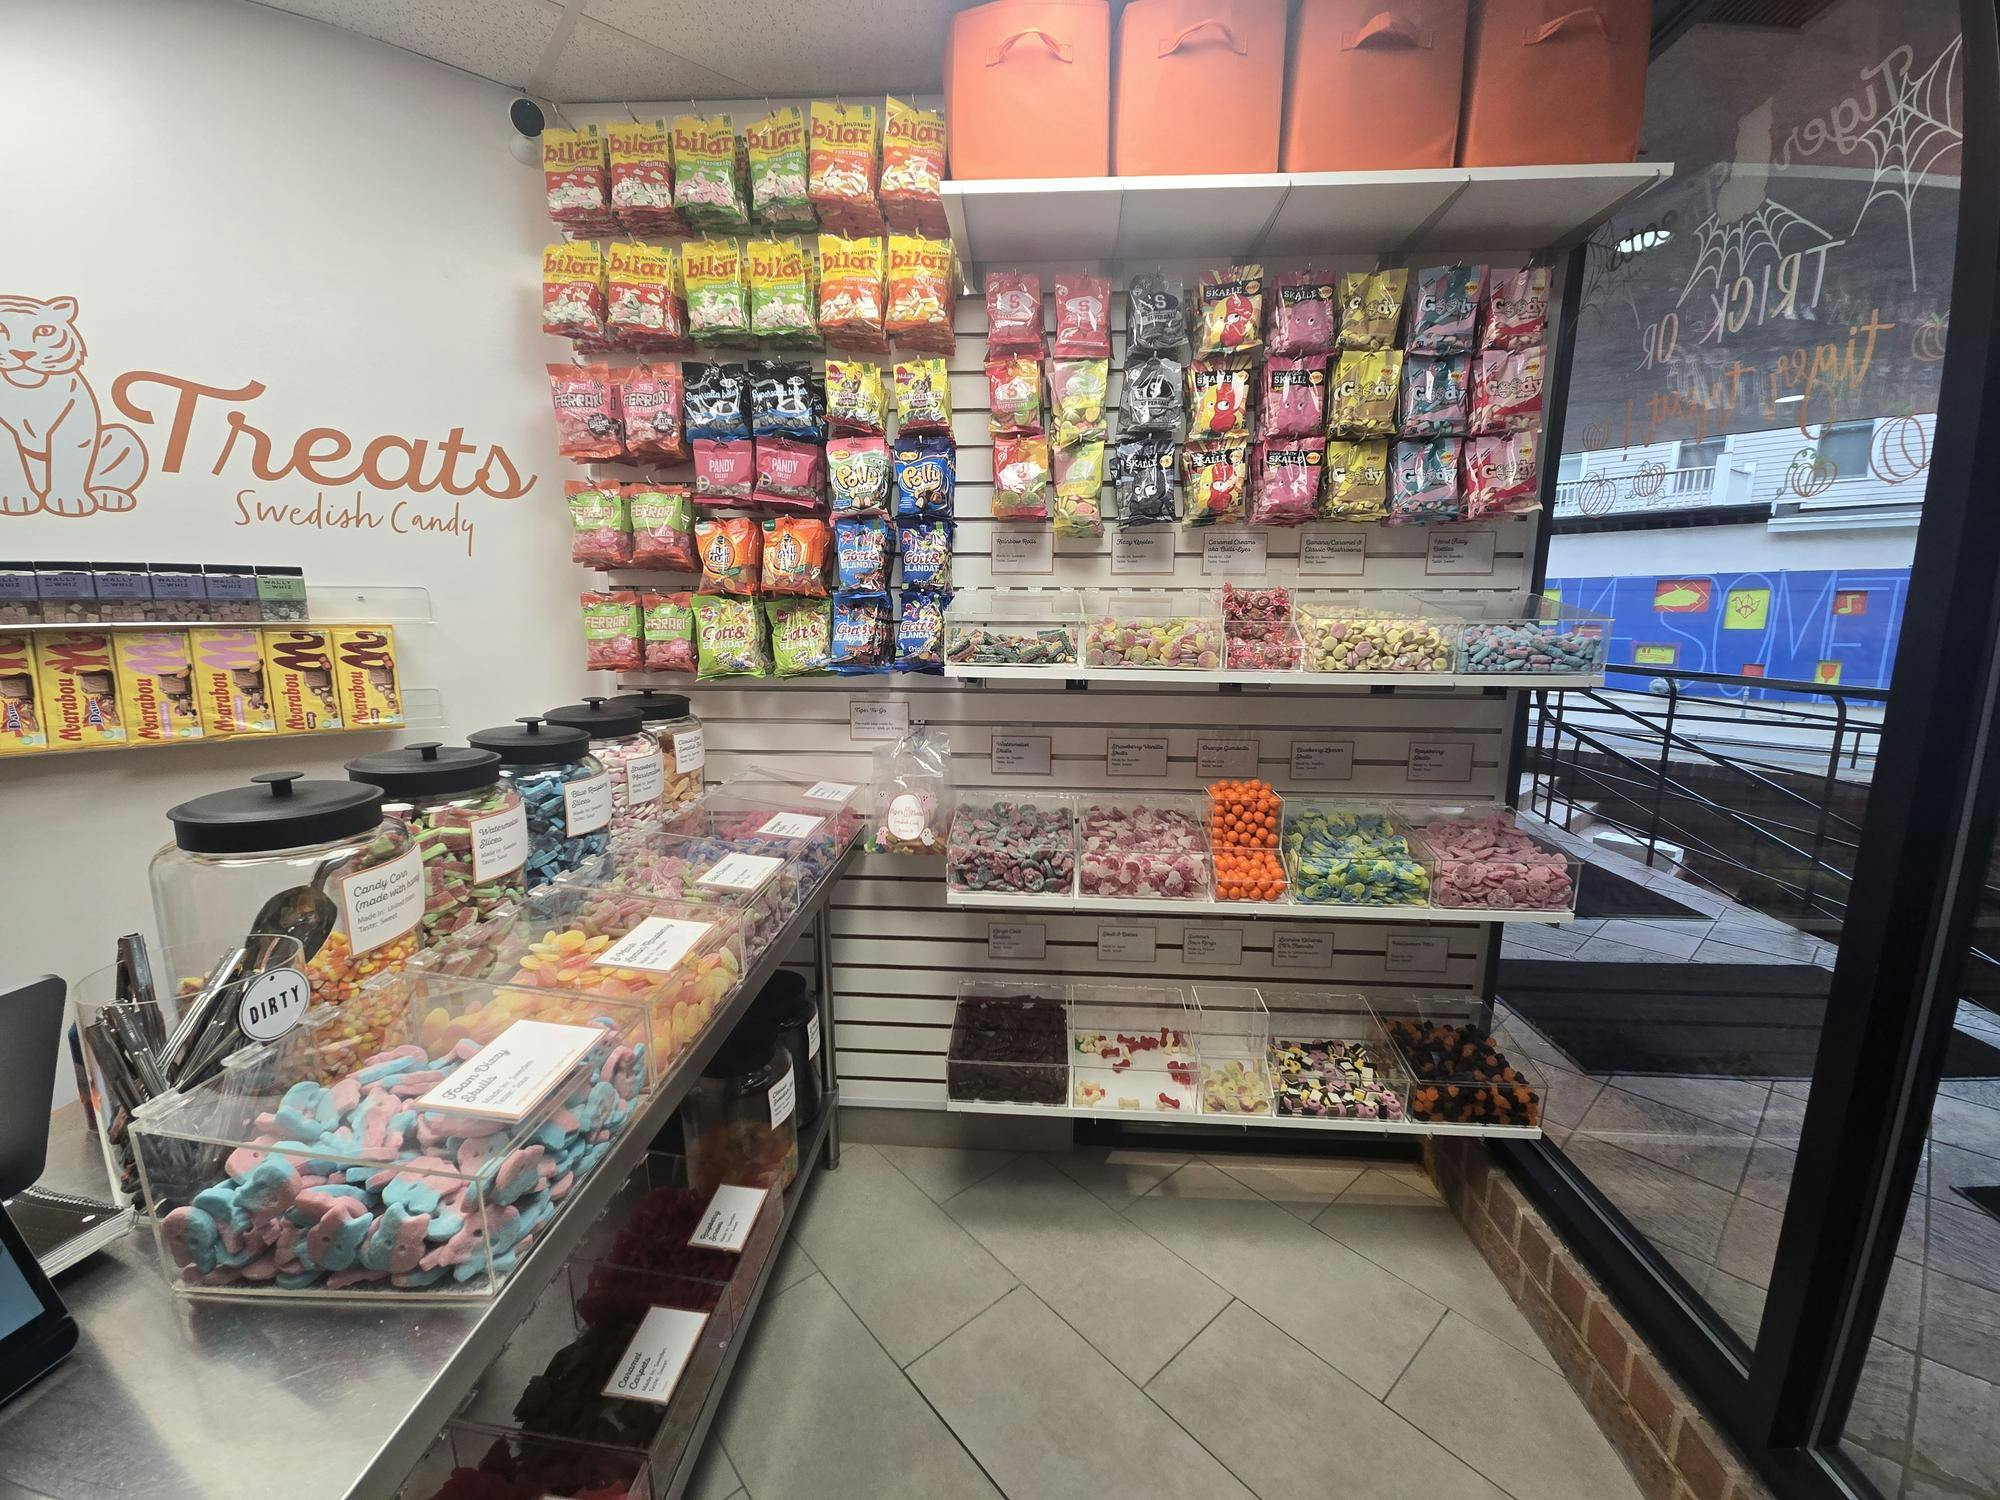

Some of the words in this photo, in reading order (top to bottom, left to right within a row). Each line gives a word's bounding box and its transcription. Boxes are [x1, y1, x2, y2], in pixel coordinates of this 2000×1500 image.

[746, 129, 803, 150] bilar
[811, 117, 871, 145] bilar
[886, 113, 943, 144] bilar
[610, 134, 665, 155] bilar
[674, 129, 732, 154] bilar
[545, 143, 601, 164] bilar
[544, 253, 599, 274] bilar
[610, 252, 668, 277] bilar
[687, 255, 738, 278] bilar
[822, 251, 877, 271] bilar
[892, 249, 950, 271] bilar
[1206, 284, 1243, 299] SKALLE
[1284, 288, 1318, 300] SKALLE
[1422, 296, 1478, 319] Goody
[623, 392, 670, 408] FERRARI
[1340, 381, 1397, 402] Goody
[1486, 377, 1545, 403] Goody
[111, 371, 537, 499] Treats
[709, 458, 736, 474] PANDY
[772, 457, 799, 475] PANDY
[1126, 457, 1159, 469] SKALLE
[1269, 454, 1303, 464] SKALLE
[1483, 458, 1537, 482] Goody
[837, 462, 878, 491] Polly
[902, 463, 942, 491] Polly
[1332, 467, 1385, 486] Goody
[1402, 465, 1458, 486] Goody
[235, 490, 384, 527] Swedish
[391, 501, 475, 557] Candy
[904, 564, 939, 573] BLANDAT
[584, 615, 630, 630] FERRARI
[645, 617, 687, 631] FERRARI
[54, 678, 83, 741] Marabou
[133, 678, 161, 740] Marabou
[209, 672, 235, 732] Marabou
[281, 673, 306, 730] Marabou
[348, 671, 370, 725] Marabou
[90, 699, 103, 726] Daim
[479, 836, 503, 849] Slices
[353, 879, 388, 898] Candy
[355, 892, 388, 913] (made
[390, 885, 407, 899] with
[358, 912, 377, 924] Made
[380, 913, 399, 925] Sweet
[250, 985, 299, 1025] DIRTY
[441, 1072, 480, 1101] Foam
[479, 1049, 512, 1073] Dizzy
[461, 1076, 498, 1103] Skulls
[618, 1352, 643, 1389] Caramel
[628, 1357, 652, 1390] Carpets
